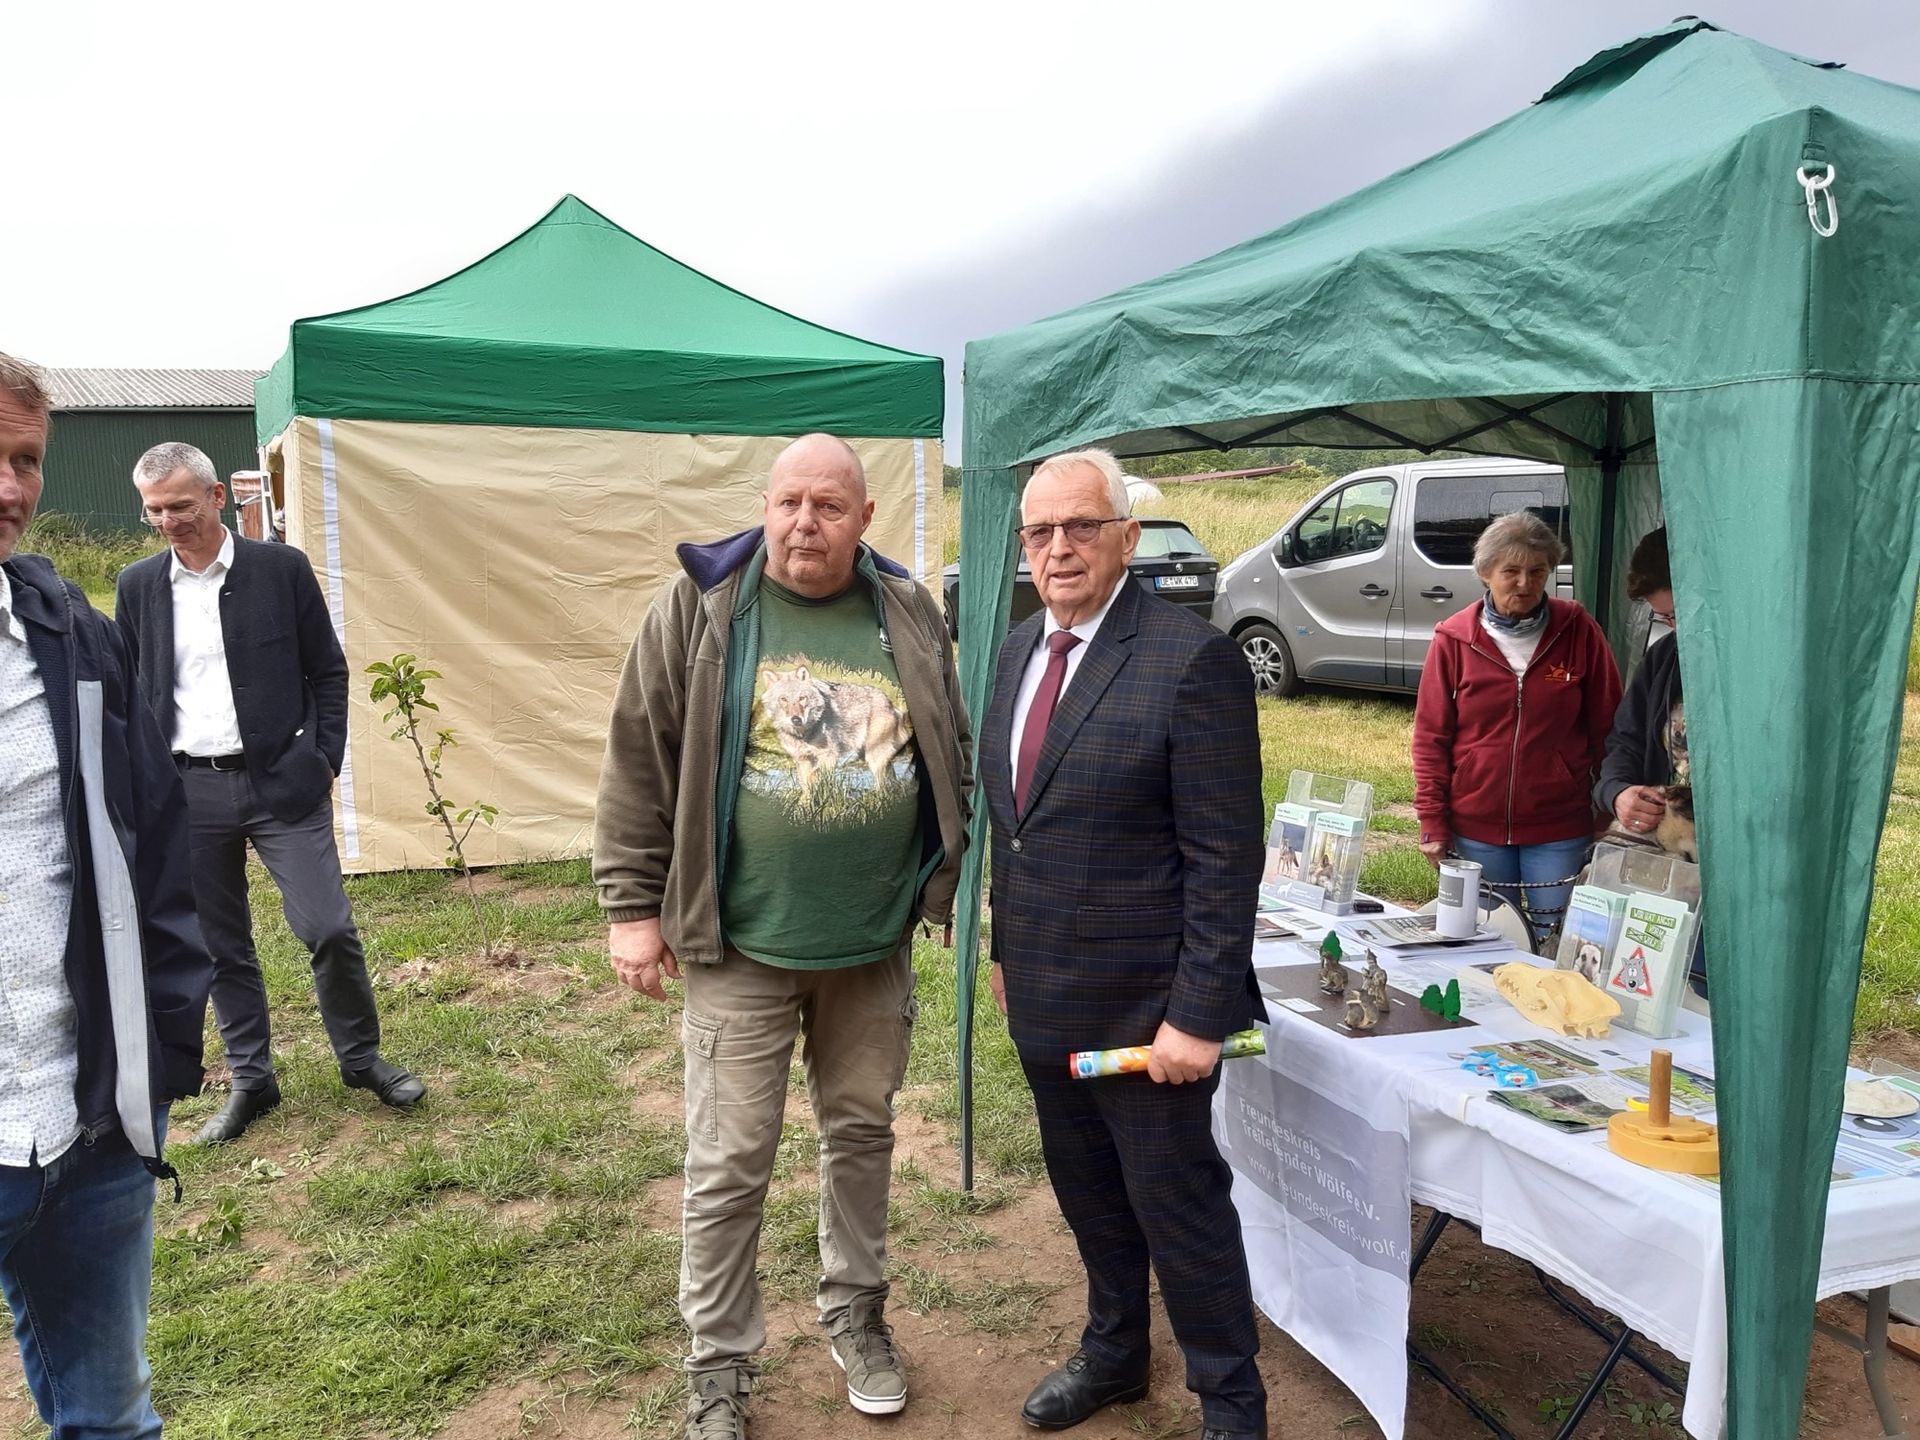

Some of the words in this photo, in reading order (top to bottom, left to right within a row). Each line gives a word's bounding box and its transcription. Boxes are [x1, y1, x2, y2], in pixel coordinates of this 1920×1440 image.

[1239, 1097, 1321, 1161] Freundeskreis
[1242, 1119, 1313, 1177] freilebender
[1314, 1165, 1353, 1203] Wölfe
